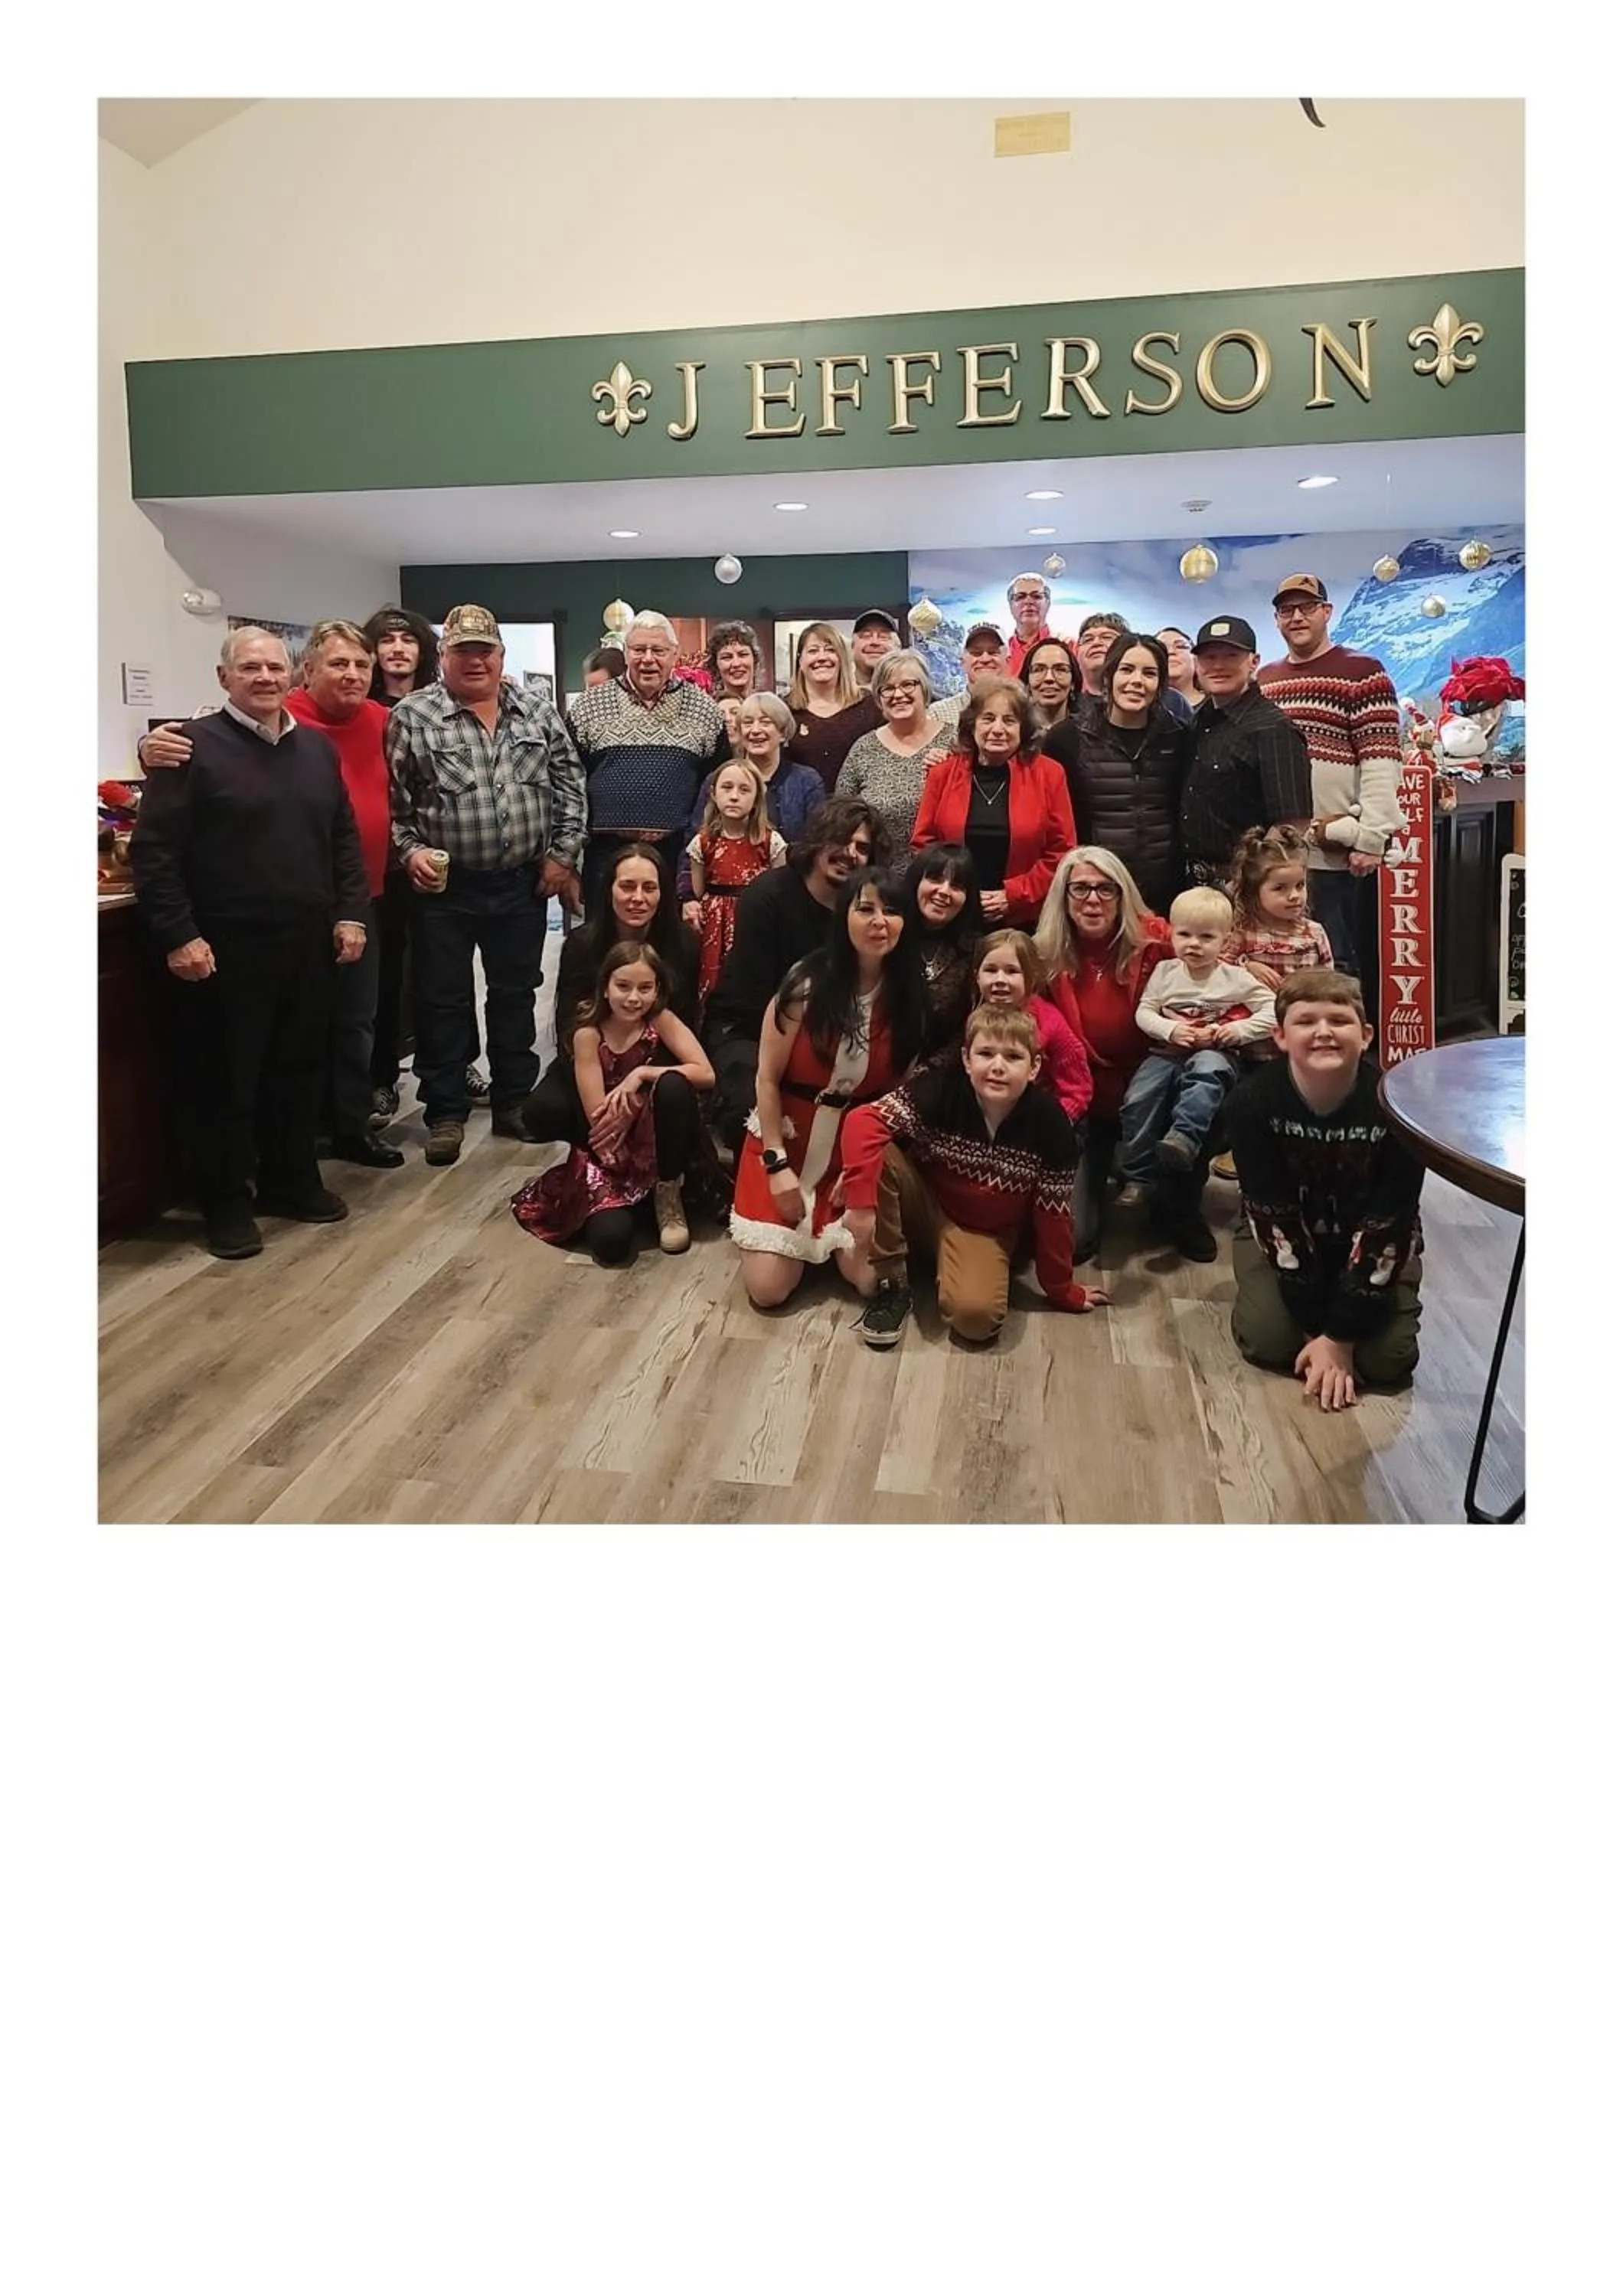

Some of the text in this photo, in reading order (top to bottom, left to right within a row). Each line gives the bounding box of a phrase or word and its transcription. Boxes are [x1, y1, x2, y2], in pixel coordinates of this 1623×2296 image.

[667, 317, 1377, 441] JEFFERSON
[1399, 773, 1425, 791] AVE
[1396, 792, 1422, 807] OUR
[1390, 836, 1425, 1005] MERRY
[1390, 1006, 1423, 1024] little
[1387, 1023, 1425, 1045] CHRIST
[1388, 1045, 1426, 1063] MA
